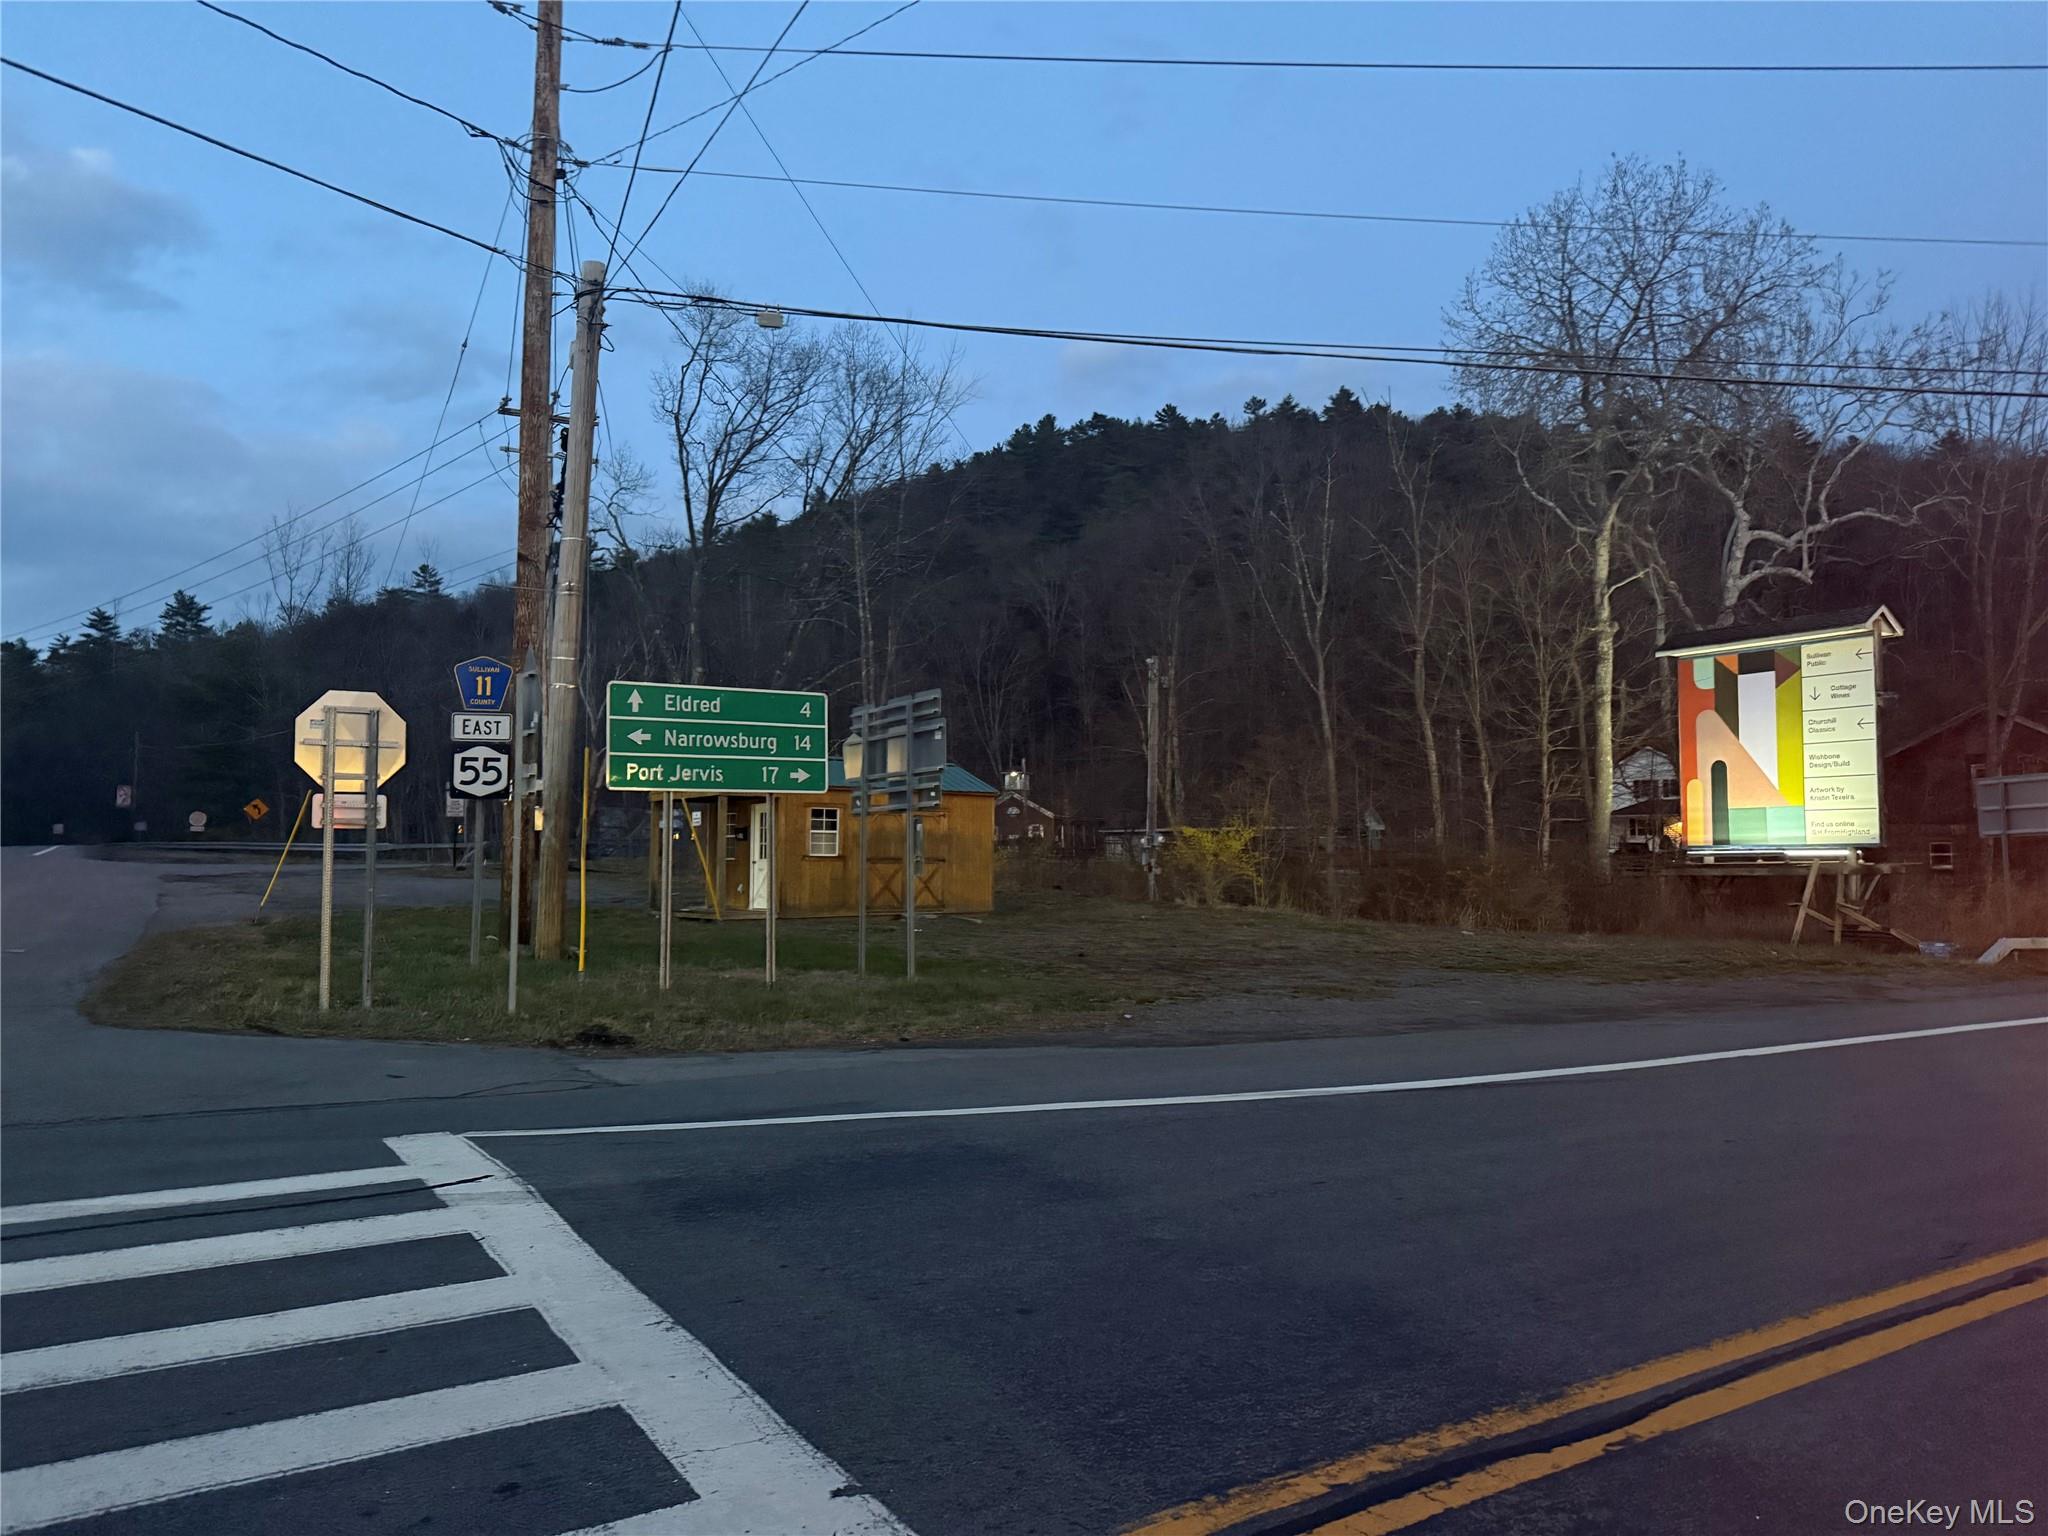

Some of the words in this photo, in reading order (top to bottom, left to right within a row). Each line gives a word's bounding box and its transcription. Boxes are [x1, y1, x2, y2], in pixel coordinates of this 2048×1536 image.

[468, 665, 500, 673] SULLIVAN
[476, 675, 492, 696] 11
[664, 694, 721, 713] Eldred
[799, 702, 812, 718] 4
[463, 719, 502, 735] EAST
[664, 729, 778, 754] Narrowsburg
[794, 735, 812, 751] 14
[459, 756, 503, 786] 55
[626, 762, 664, 781] Port
[667, 764, 724, 783] Jervis
[762, 766, 779, 784] 17
[1809, 760, 1851, 769] Design/Build
